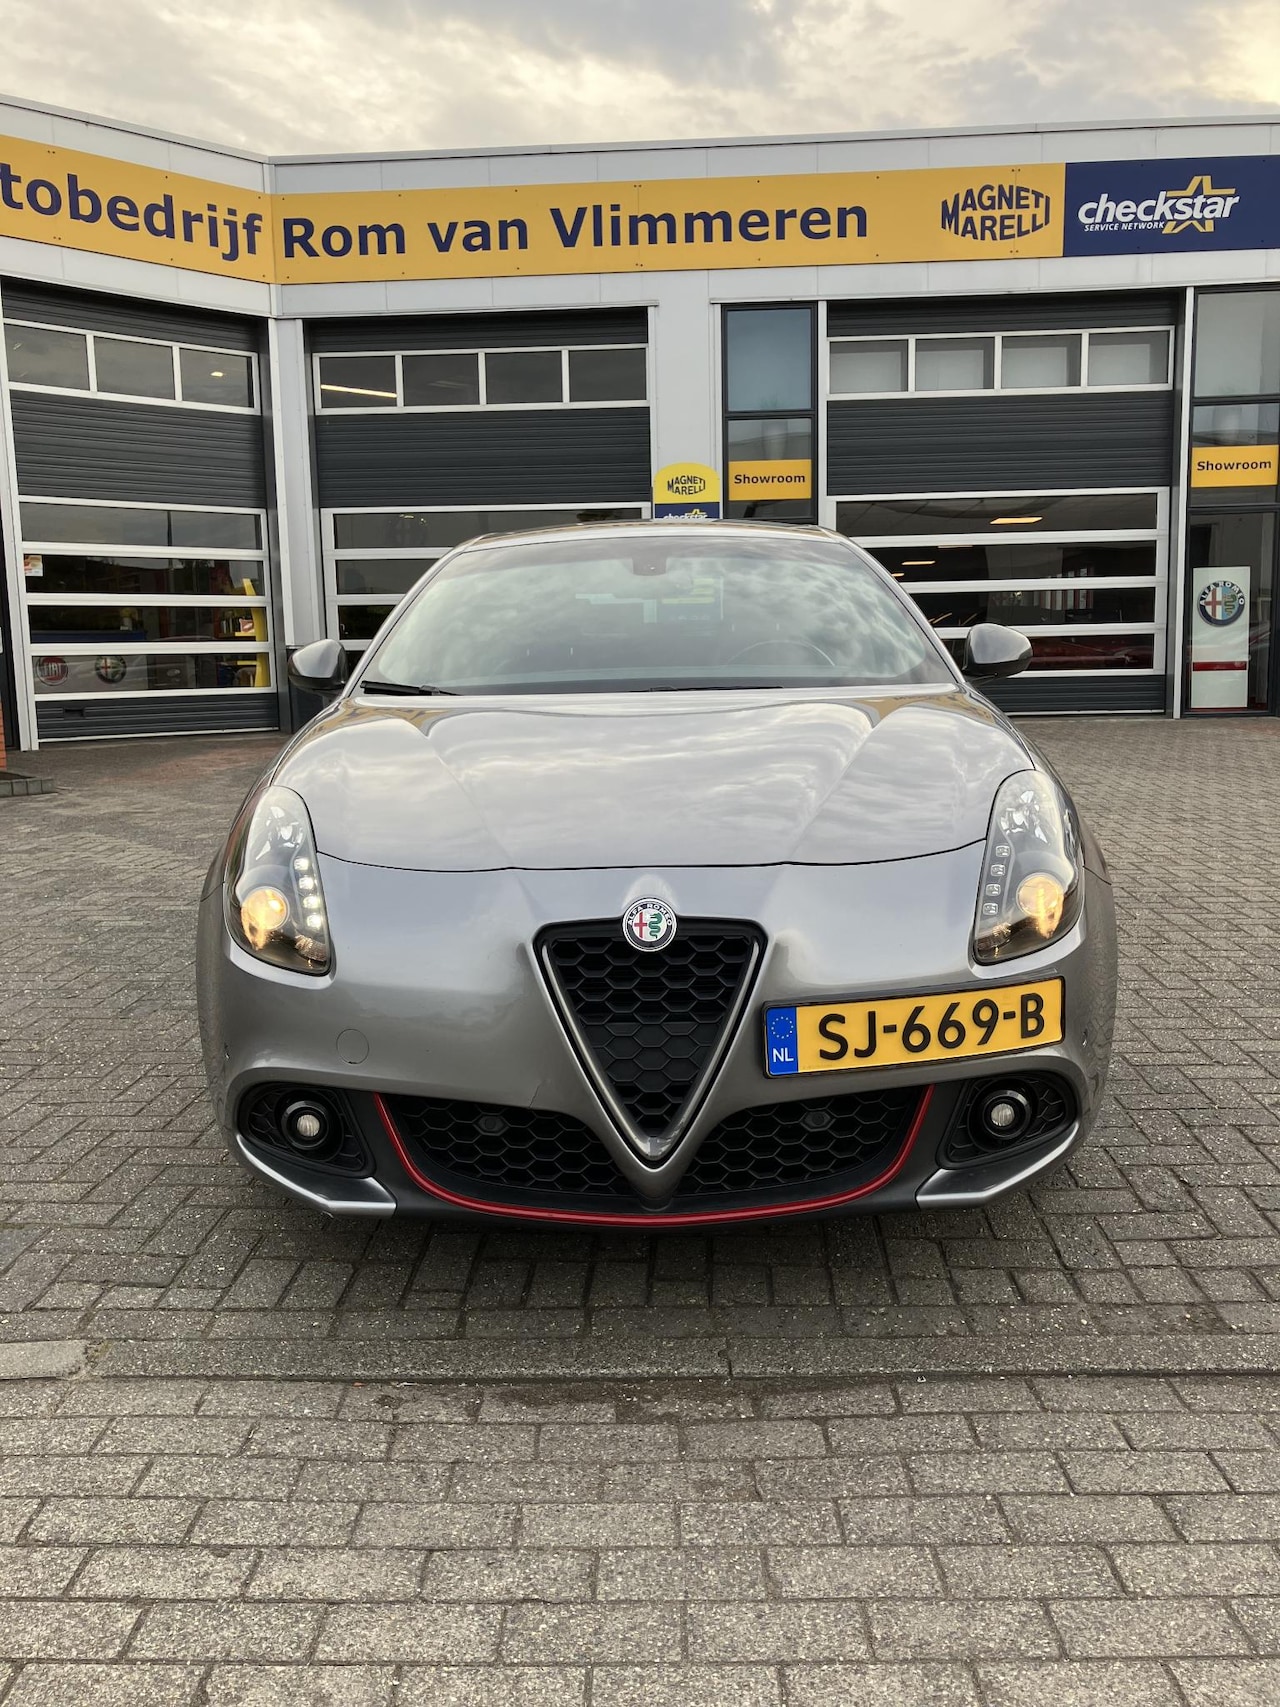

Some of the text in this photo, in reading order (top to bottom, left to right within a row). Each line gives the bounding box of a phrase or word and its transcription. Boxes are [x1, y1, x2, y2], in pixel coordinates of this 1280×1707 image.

[941, 183, 1050, 232] MAGNETI
[941, 194, 1050, 241] MARELLI
[1078, 191, 1240, 224] checkstar
[283, 203, 868, 258] Rom van Vlimmeren
[1084, 221, 1165, 231] SERVICE NETWORK
[1197, 460, 1272, 471] Showroom
[734, 474, 805, 484] Showroom
[1200, 580, 1245, 606] ALFA ROMEO
[43, 661, 62, 677] FIAT
[628, 903, 672, 926] ALFA ROMEO
[818, 992, 1044, 1060] SJ-669-B
[772, 1048, 794, 1062] NL
